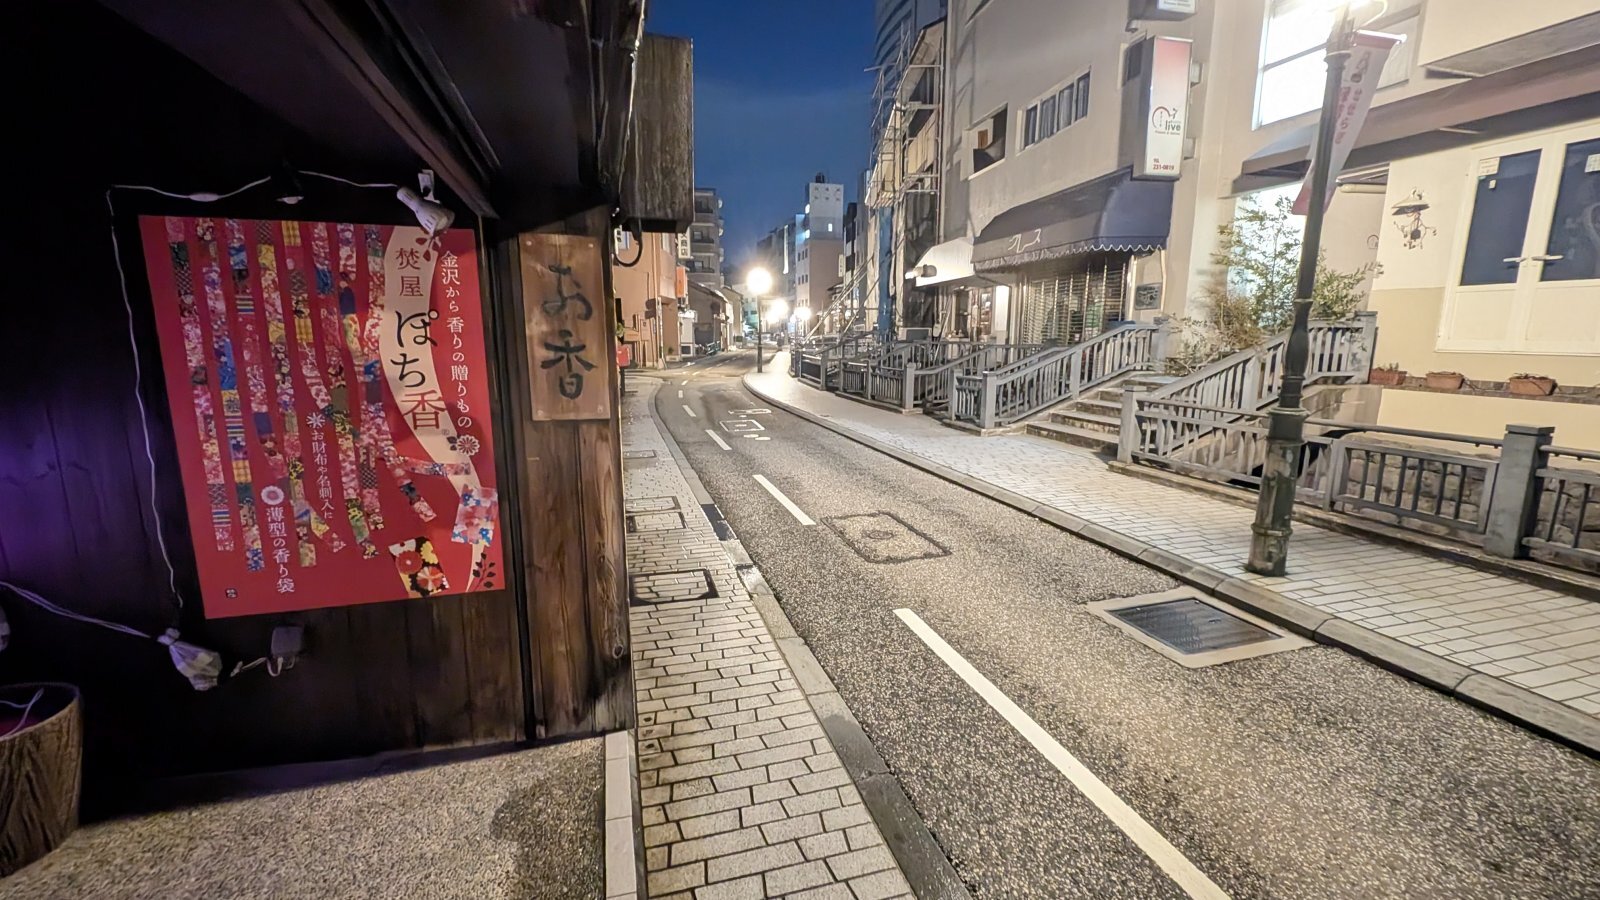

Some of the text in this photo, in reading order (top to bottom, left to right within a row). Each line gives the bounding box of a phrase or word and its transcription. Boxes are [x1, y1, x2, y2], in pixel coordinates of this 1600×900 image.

[390, 308, 446, 430] ぽち香
[440, 250, 473, 429] 金沢から香りの贈りもの
[540, 263, 598, 400] お香
[265, 506, 296, 594] 薄型の香り袋
